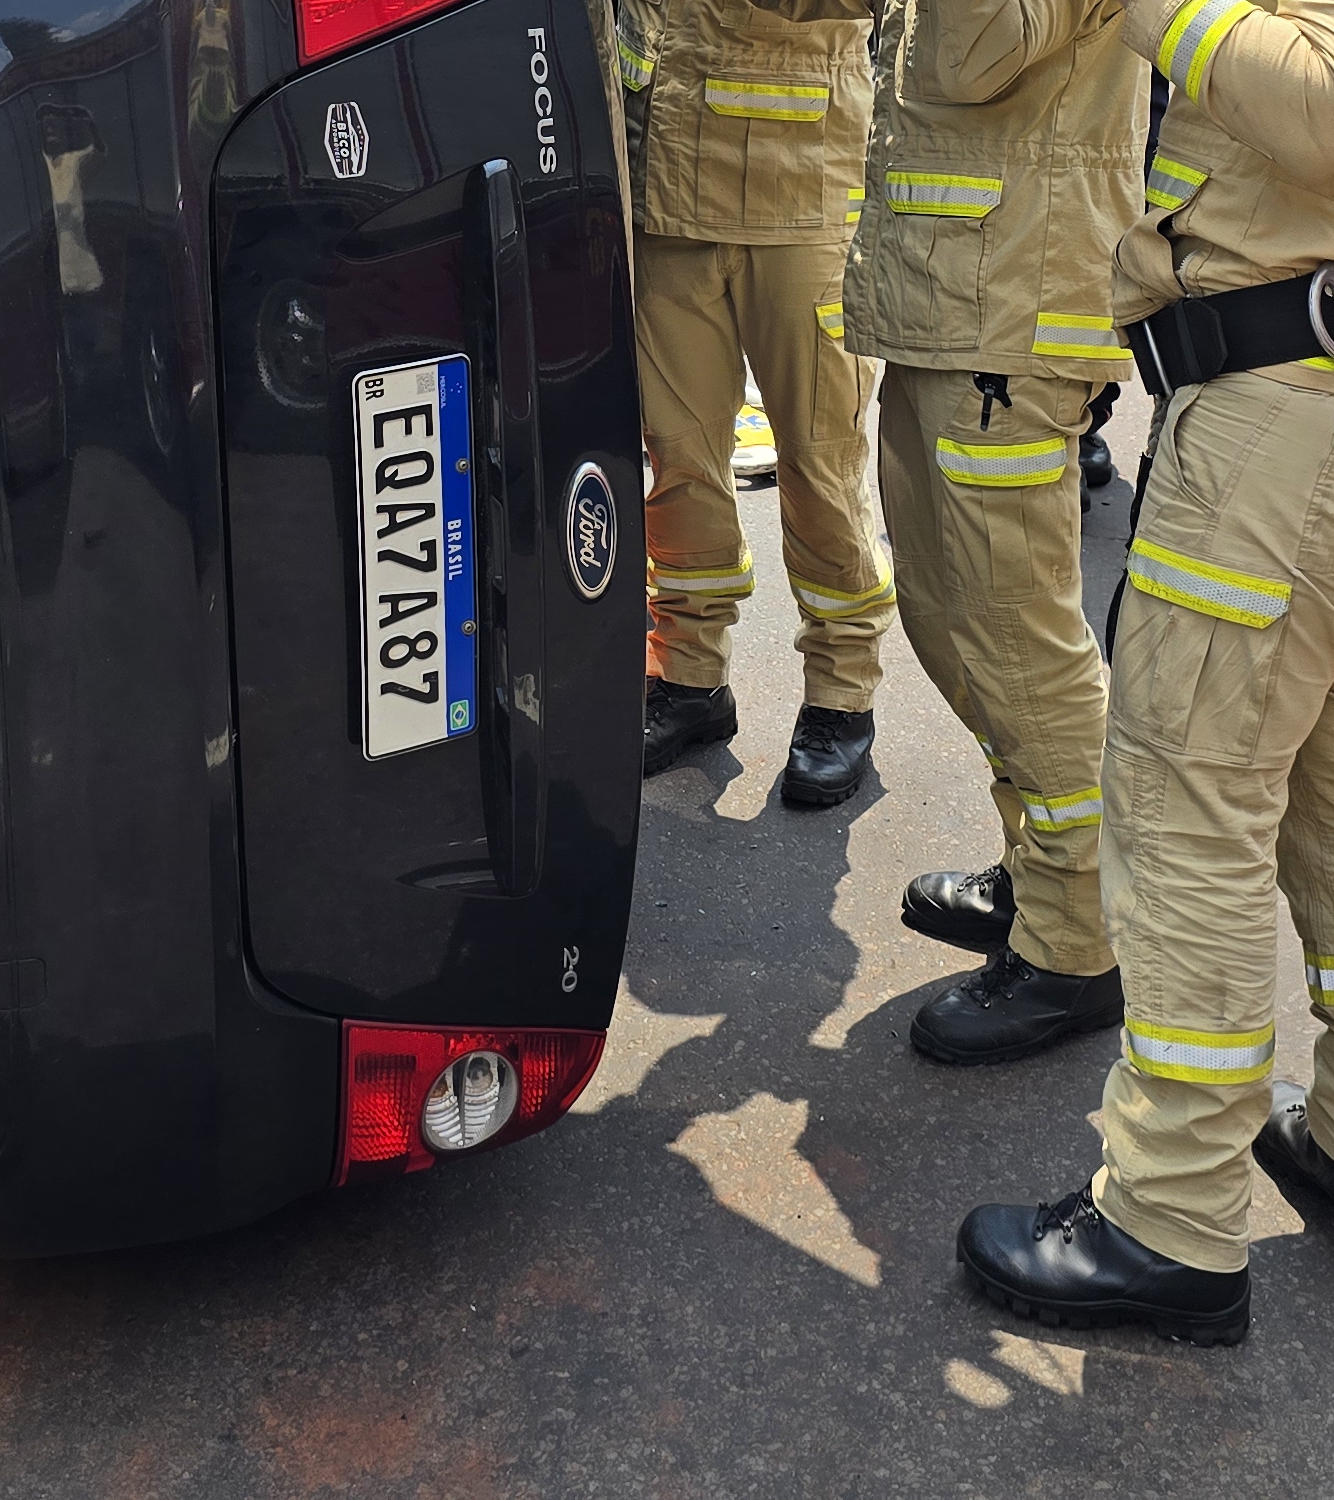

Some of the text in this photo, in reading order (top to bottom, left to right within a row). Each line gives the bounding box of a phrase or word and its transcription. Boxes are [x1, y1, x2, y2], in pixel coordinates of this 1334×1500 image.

[527, 27, 557, 174] FOCUS
[364, 377, 385, 402] BR
[439, 375, 448, 410] MERCOSUL
[447, 518, 464, 581] BRASIL
[578, 497, 608, 569] Ford
